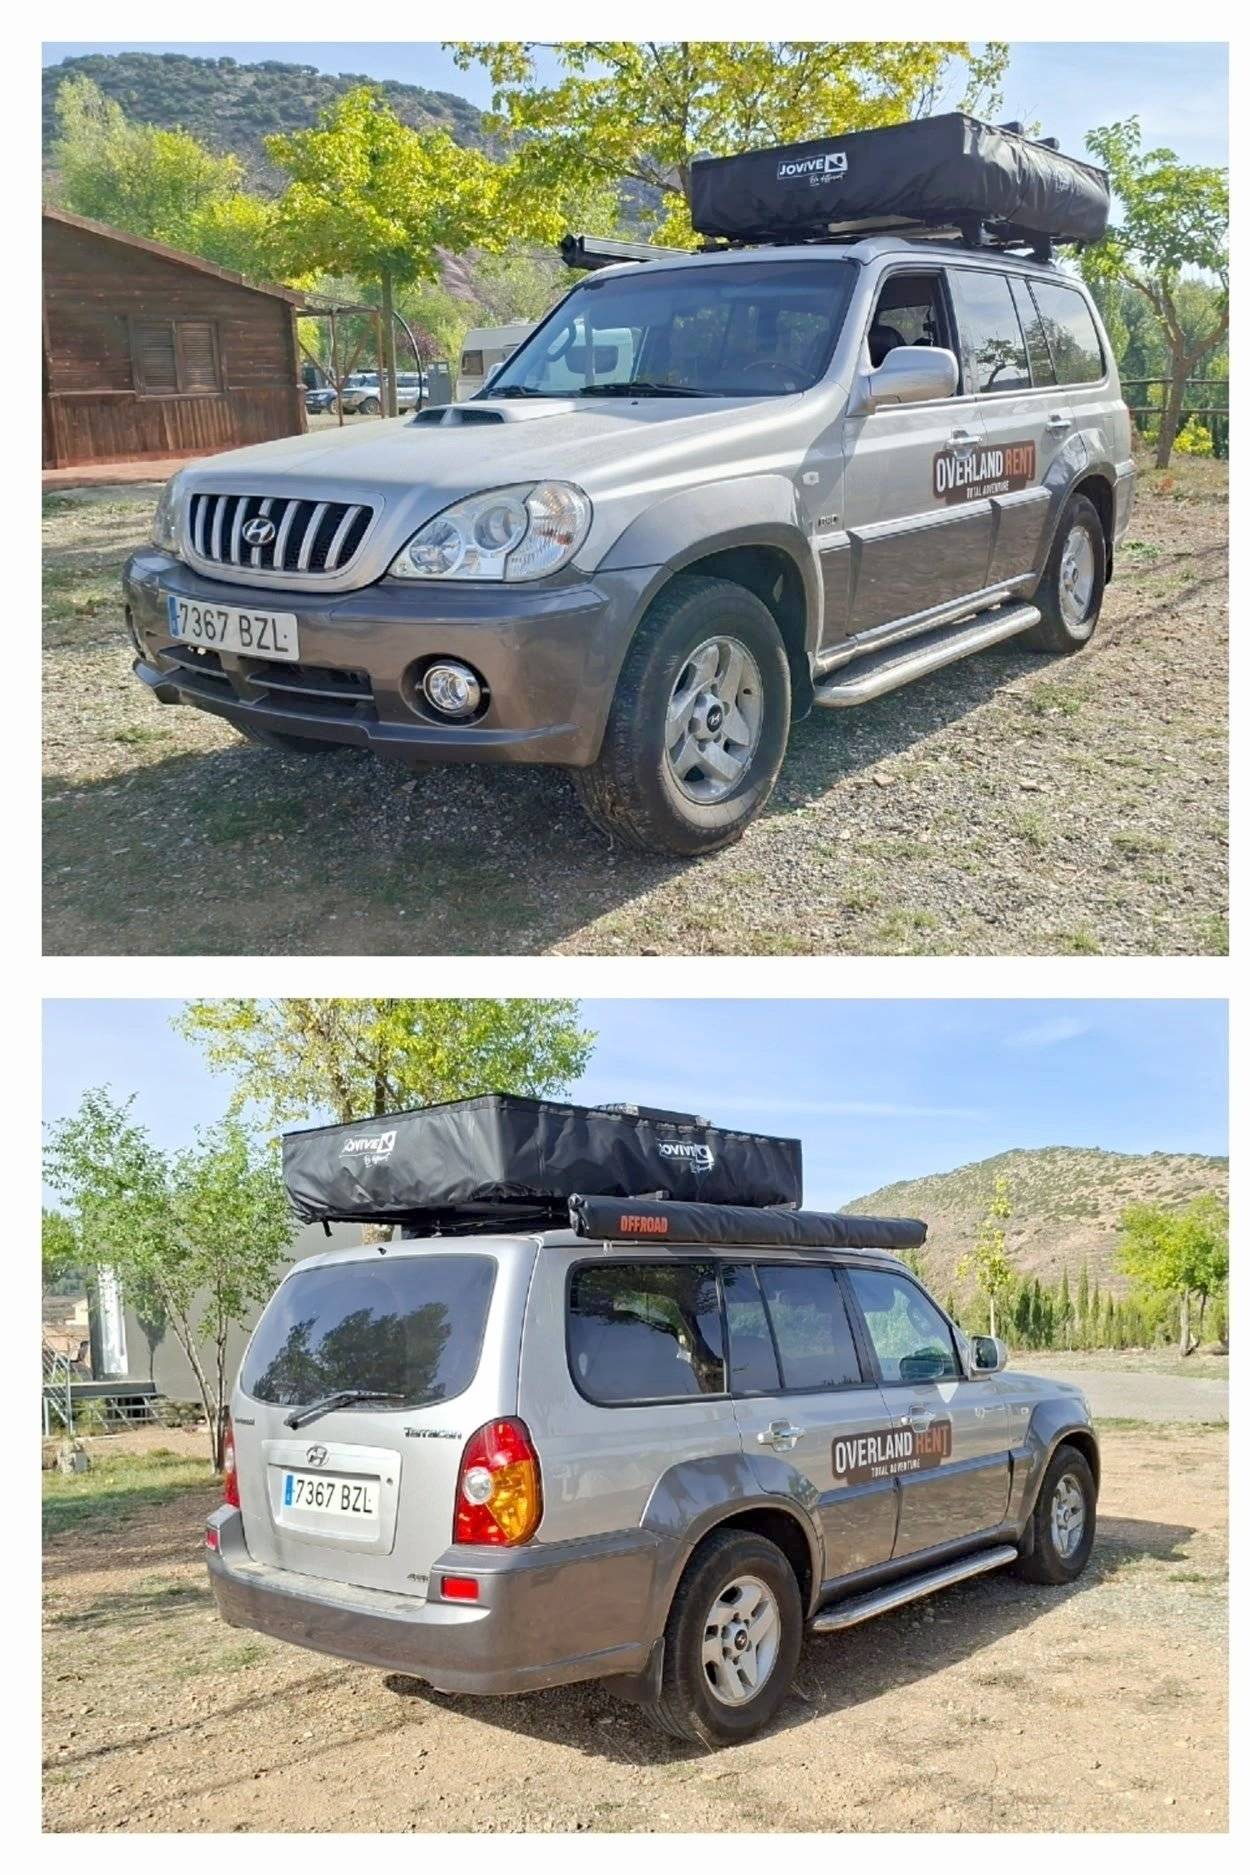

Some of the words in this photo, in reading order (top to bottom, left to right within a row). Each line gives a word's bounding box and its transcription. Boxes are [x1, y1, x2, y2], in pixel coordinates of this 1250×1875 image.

[779, 158, 824, 176] JOVIVE
[936, 450, 1004, 493] OVERLAND
[1004, 446, 1034, 479] RENT
[180, 603, 229, 642] 7367
[239, 614, 289, 653] BZL
[620, 1215, 668, 1233] OFFROAD
[835, 1431, 913, 1474] OVERLAND
[915, 1425, 949, 1455] RENT
[296, 1479, 335, 1508] 7367
[341, 1484, 372, 1513] BZL
